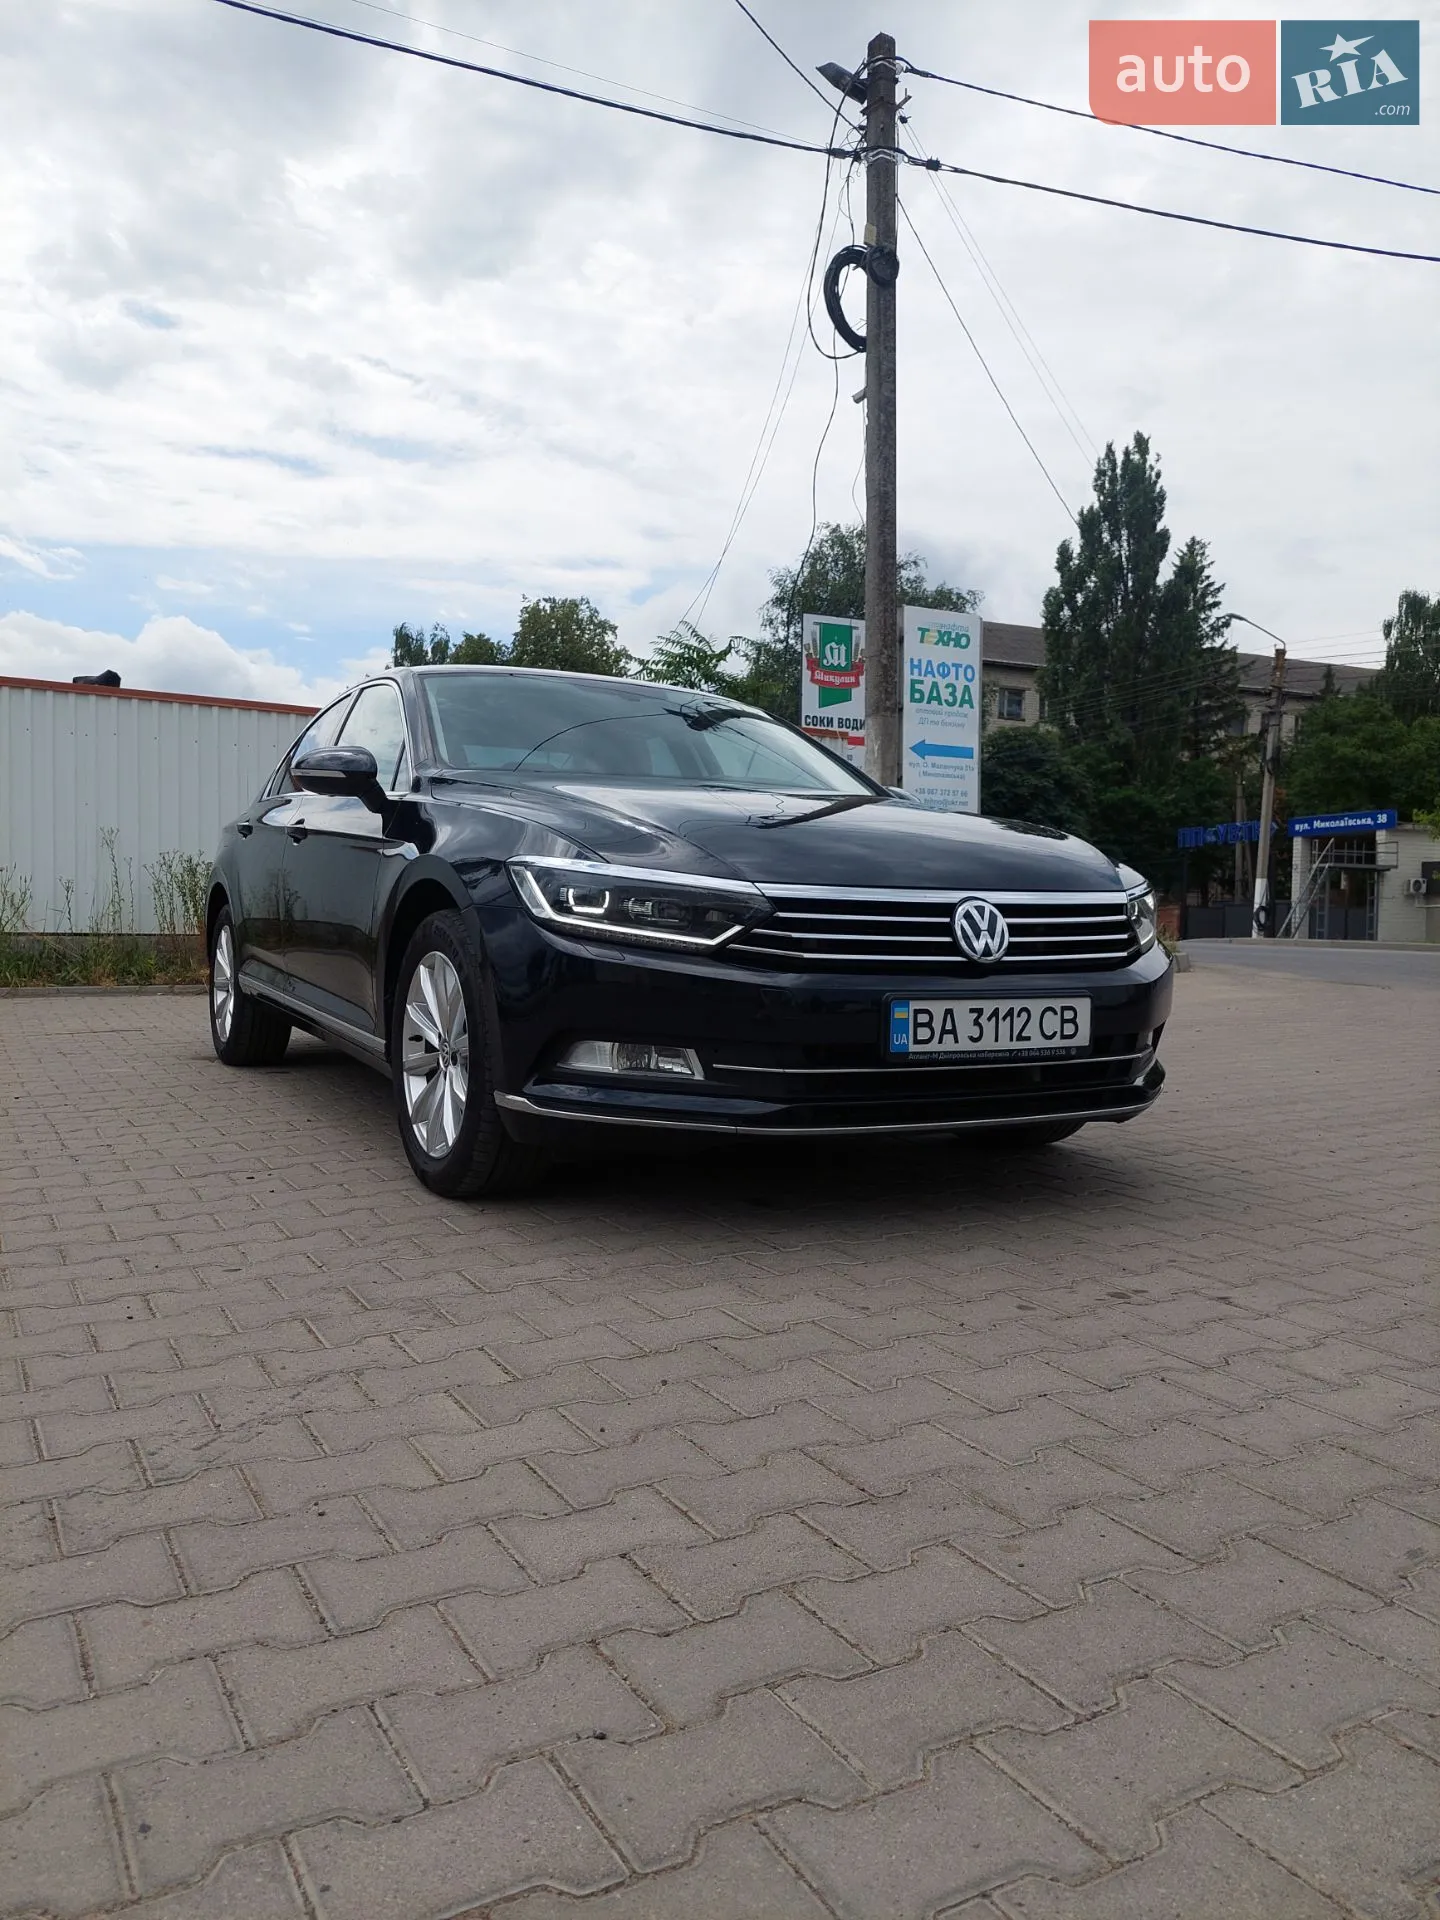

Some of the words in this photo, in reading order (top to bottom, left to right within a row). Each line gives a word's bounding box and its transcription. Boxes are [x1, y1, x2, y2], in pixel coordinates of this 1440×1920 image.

[909, 657, 976, 683] НАФТО
[909, 678, 975, 710] БАЗА
[804, 714, 834, 729] СОКИ
[837, 716, 866, 731] ВОДИ
[1294, 822, 1311, 833] вул.
[1313, 816, 1375, 830] Миколаївська,
[1376, 813, 1388, 824] 38
[913, 1007, 959, 1045] BA
[967, 1006, 1032, 1043] 3112
[1039, 1005, 1079, 1041] CB
[893, 1033, 908, 1045] UA
